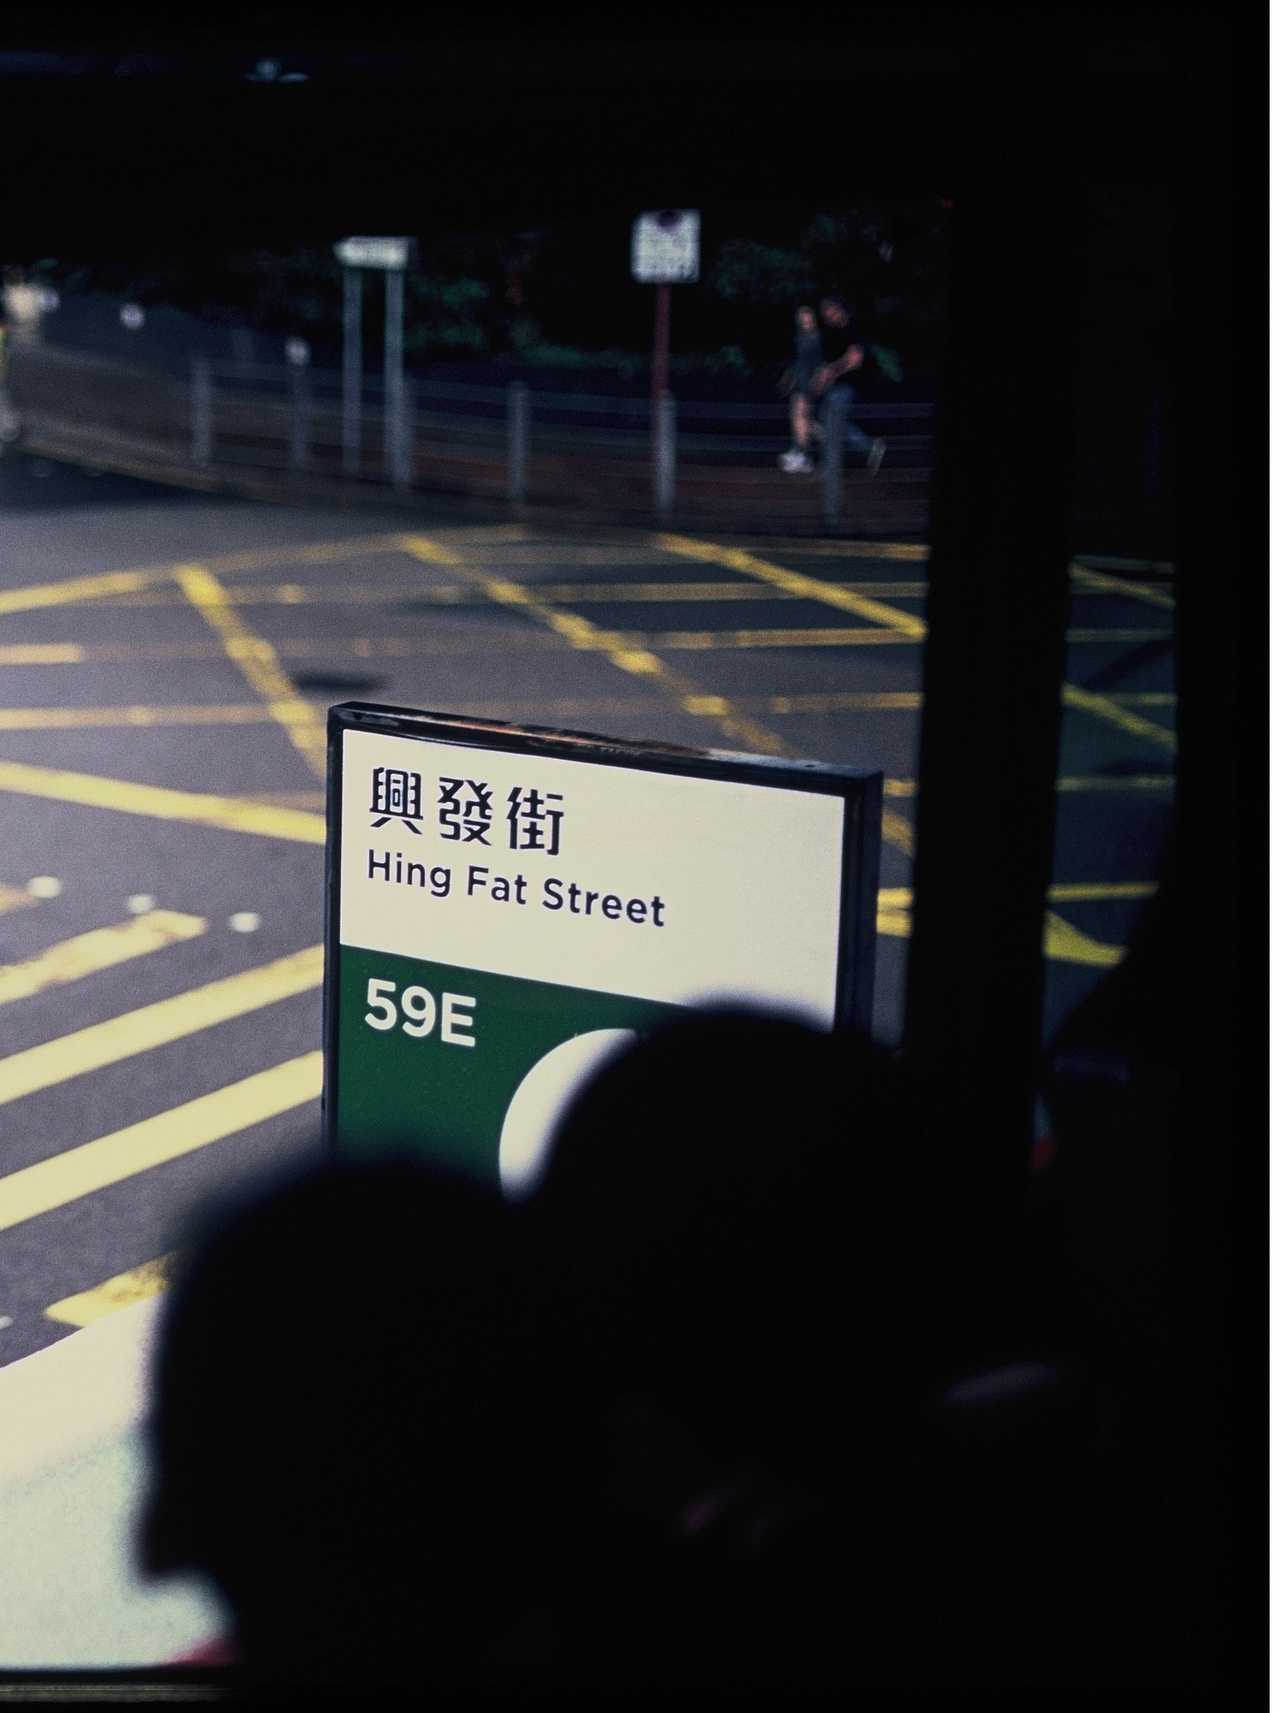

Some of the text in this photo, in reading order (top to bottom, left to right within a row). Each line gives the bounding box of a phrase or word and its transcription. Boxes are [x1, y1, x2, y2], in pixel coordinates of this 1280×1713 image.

[369, 766, 565, 856] 興發街
[367, 849, 666, 928] Hing Fat Street
[364, 978, 477, 1048] 59E
